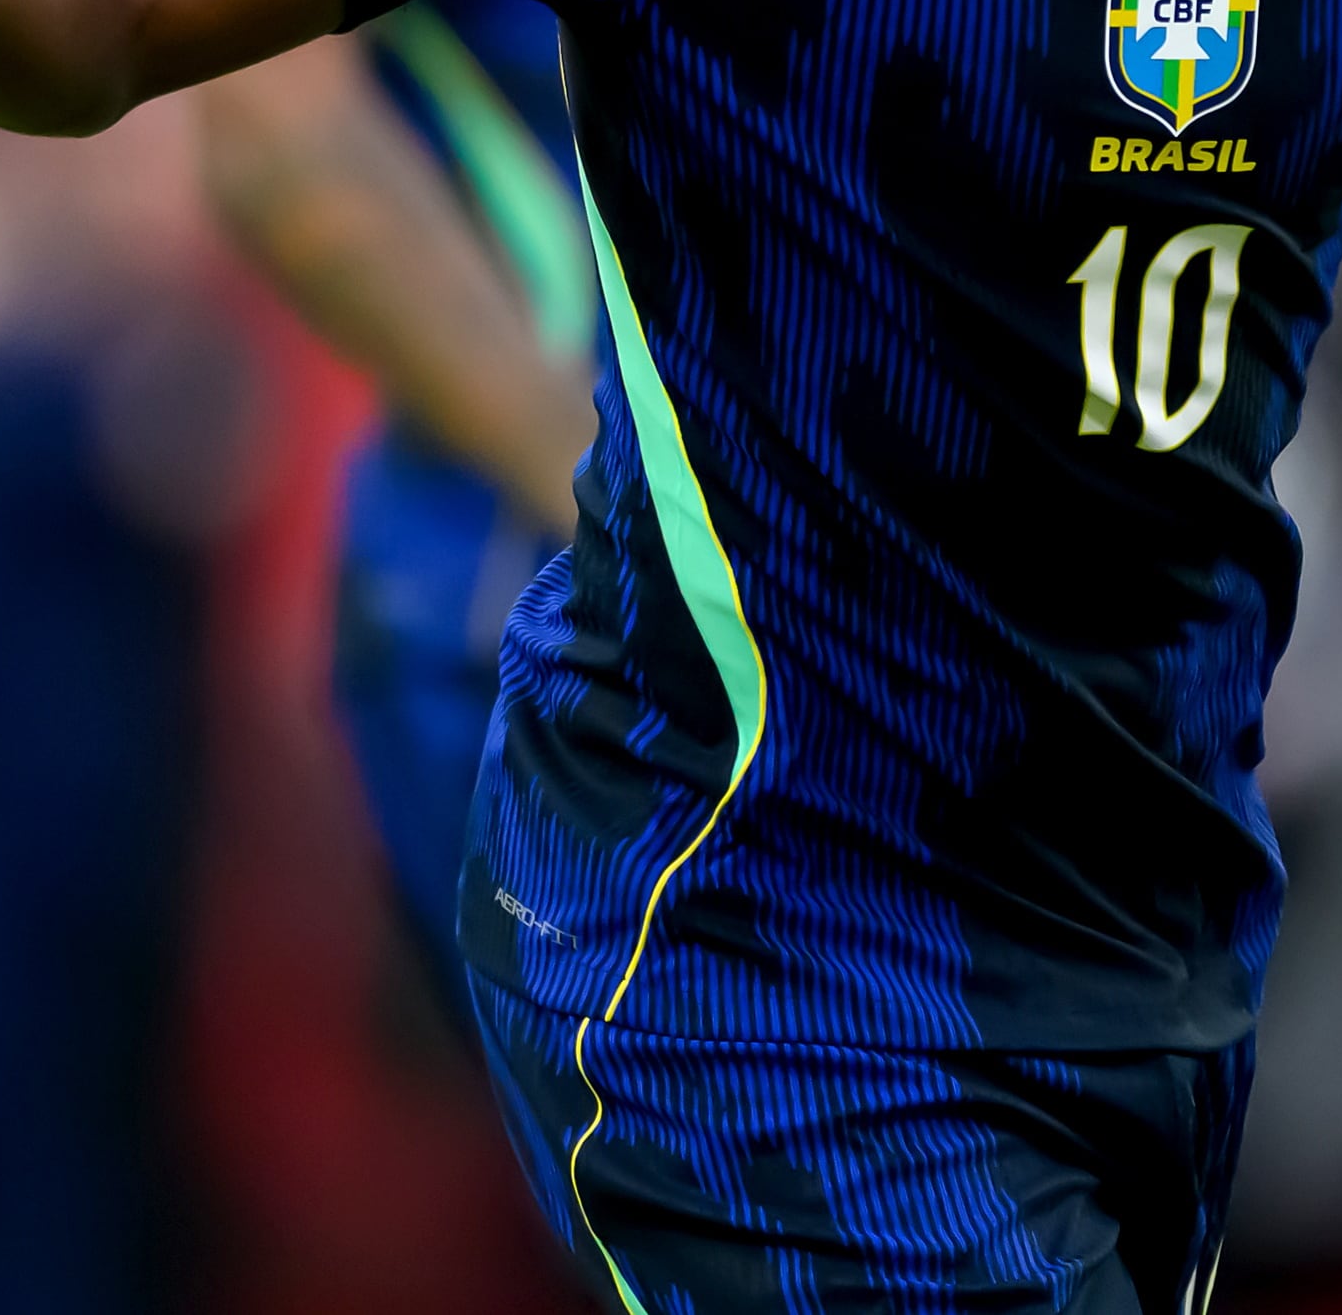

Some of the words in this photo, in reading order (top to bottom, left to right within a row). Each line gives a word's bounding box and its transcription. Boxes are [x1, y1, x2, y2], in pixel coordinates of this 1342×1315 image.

[1153, 0, 1212, 23] CBF
[1090, 137, 1256, 172] BRASIL
[1067, 225, 1254, 452] 10
